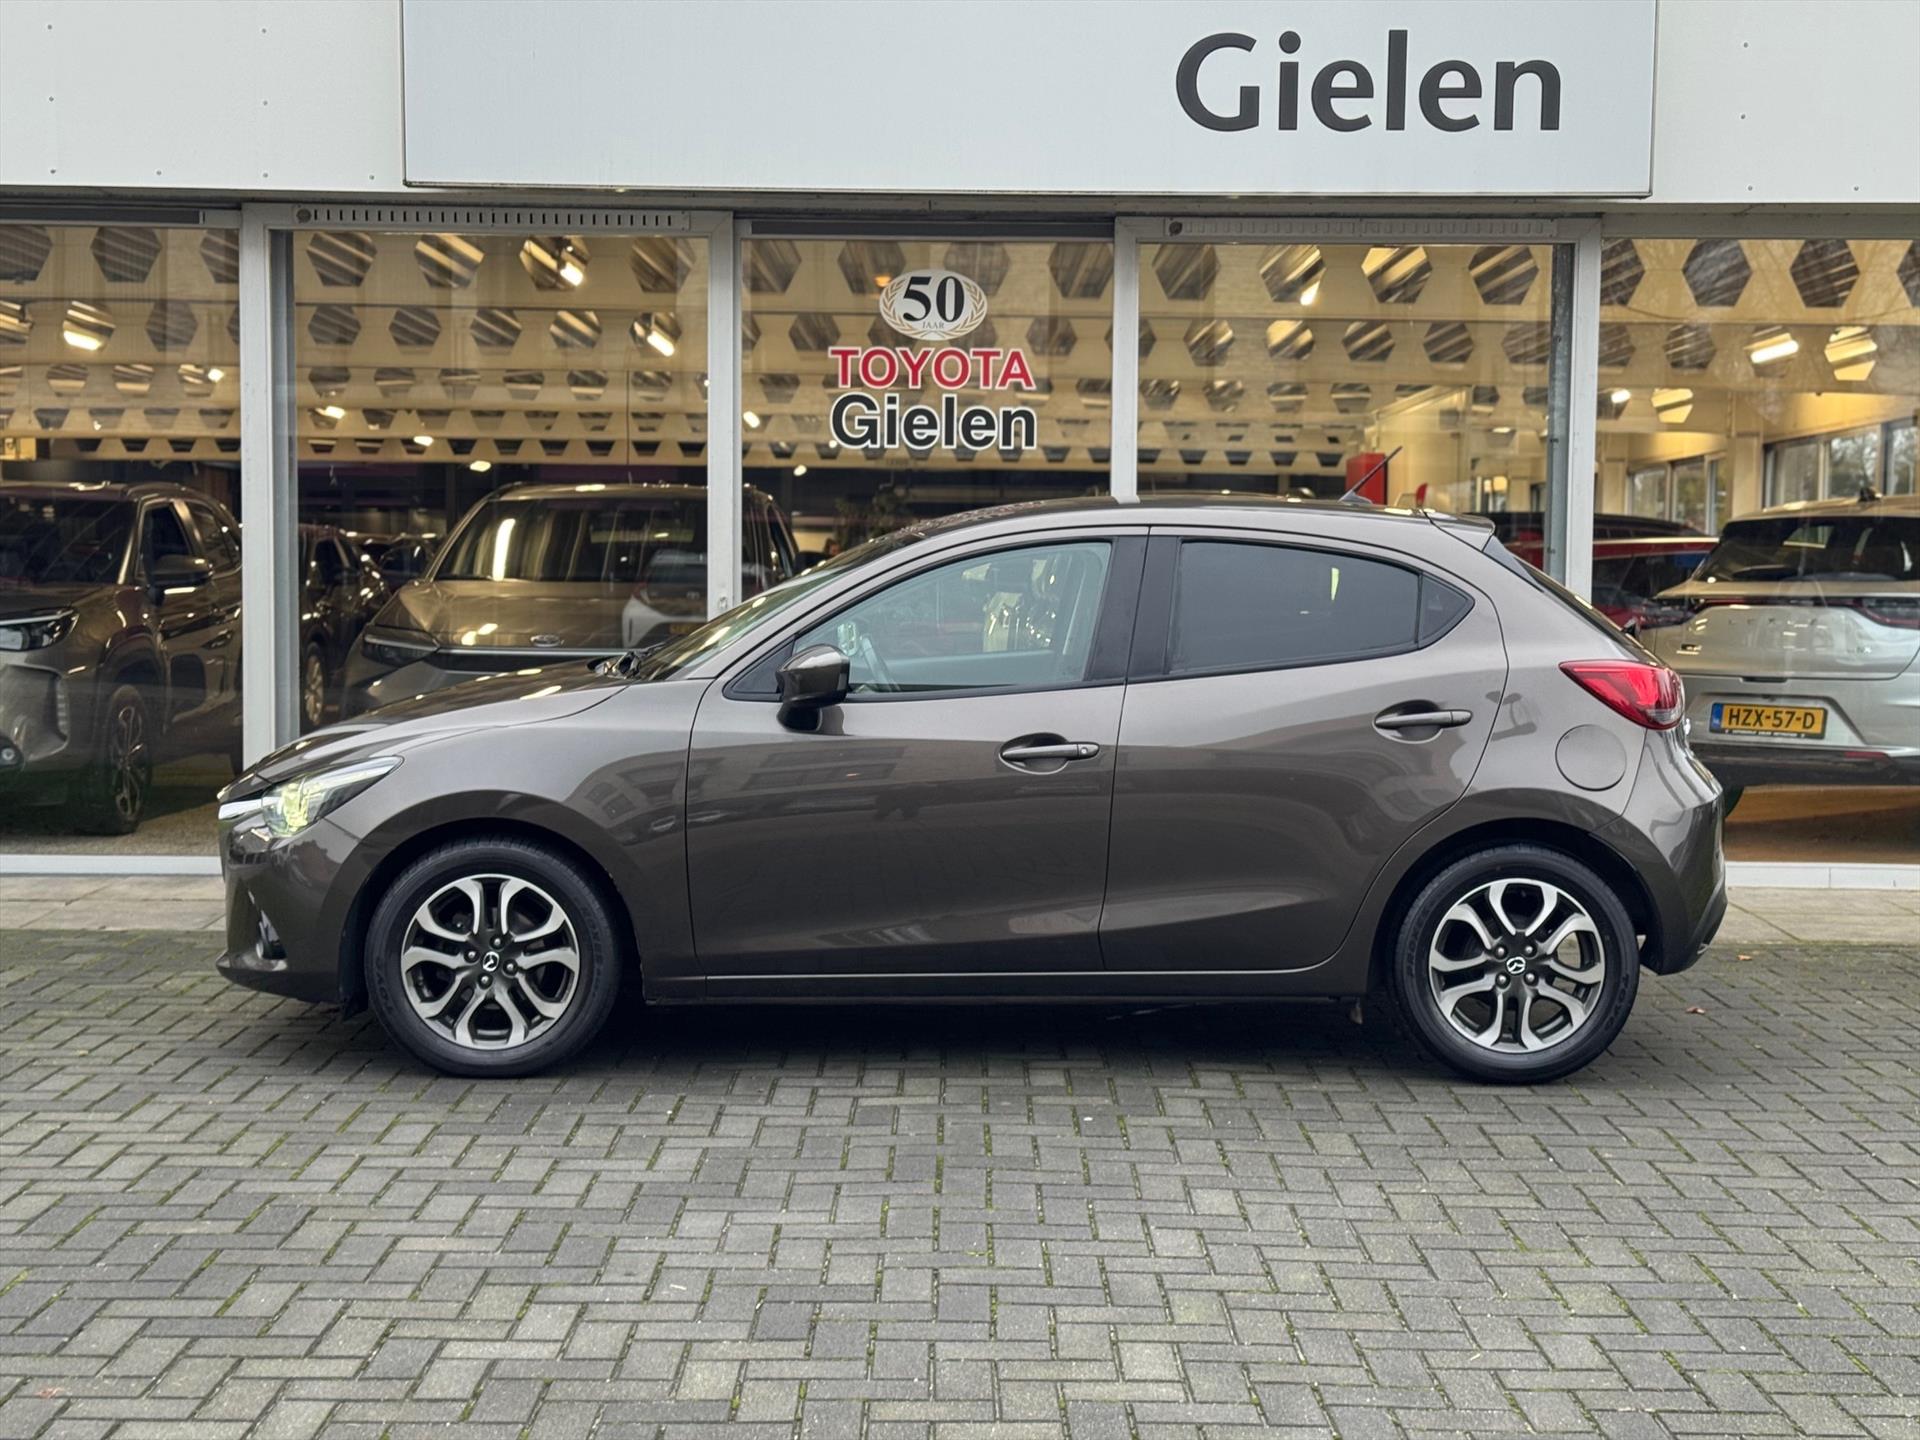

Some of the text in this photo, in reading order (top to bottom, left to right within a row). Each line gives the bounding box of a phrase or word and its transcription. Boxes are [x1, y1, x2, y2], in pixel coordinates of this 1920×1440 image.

[1176, 29, 1561, 132] Gielen
[902, 276, 965, 323] 50
[829, 347, 1036, 390] TOYOTA
[830, 392, 1037, 450] Gielen
[1727, 708, 1816, 730] HZX-57-D
